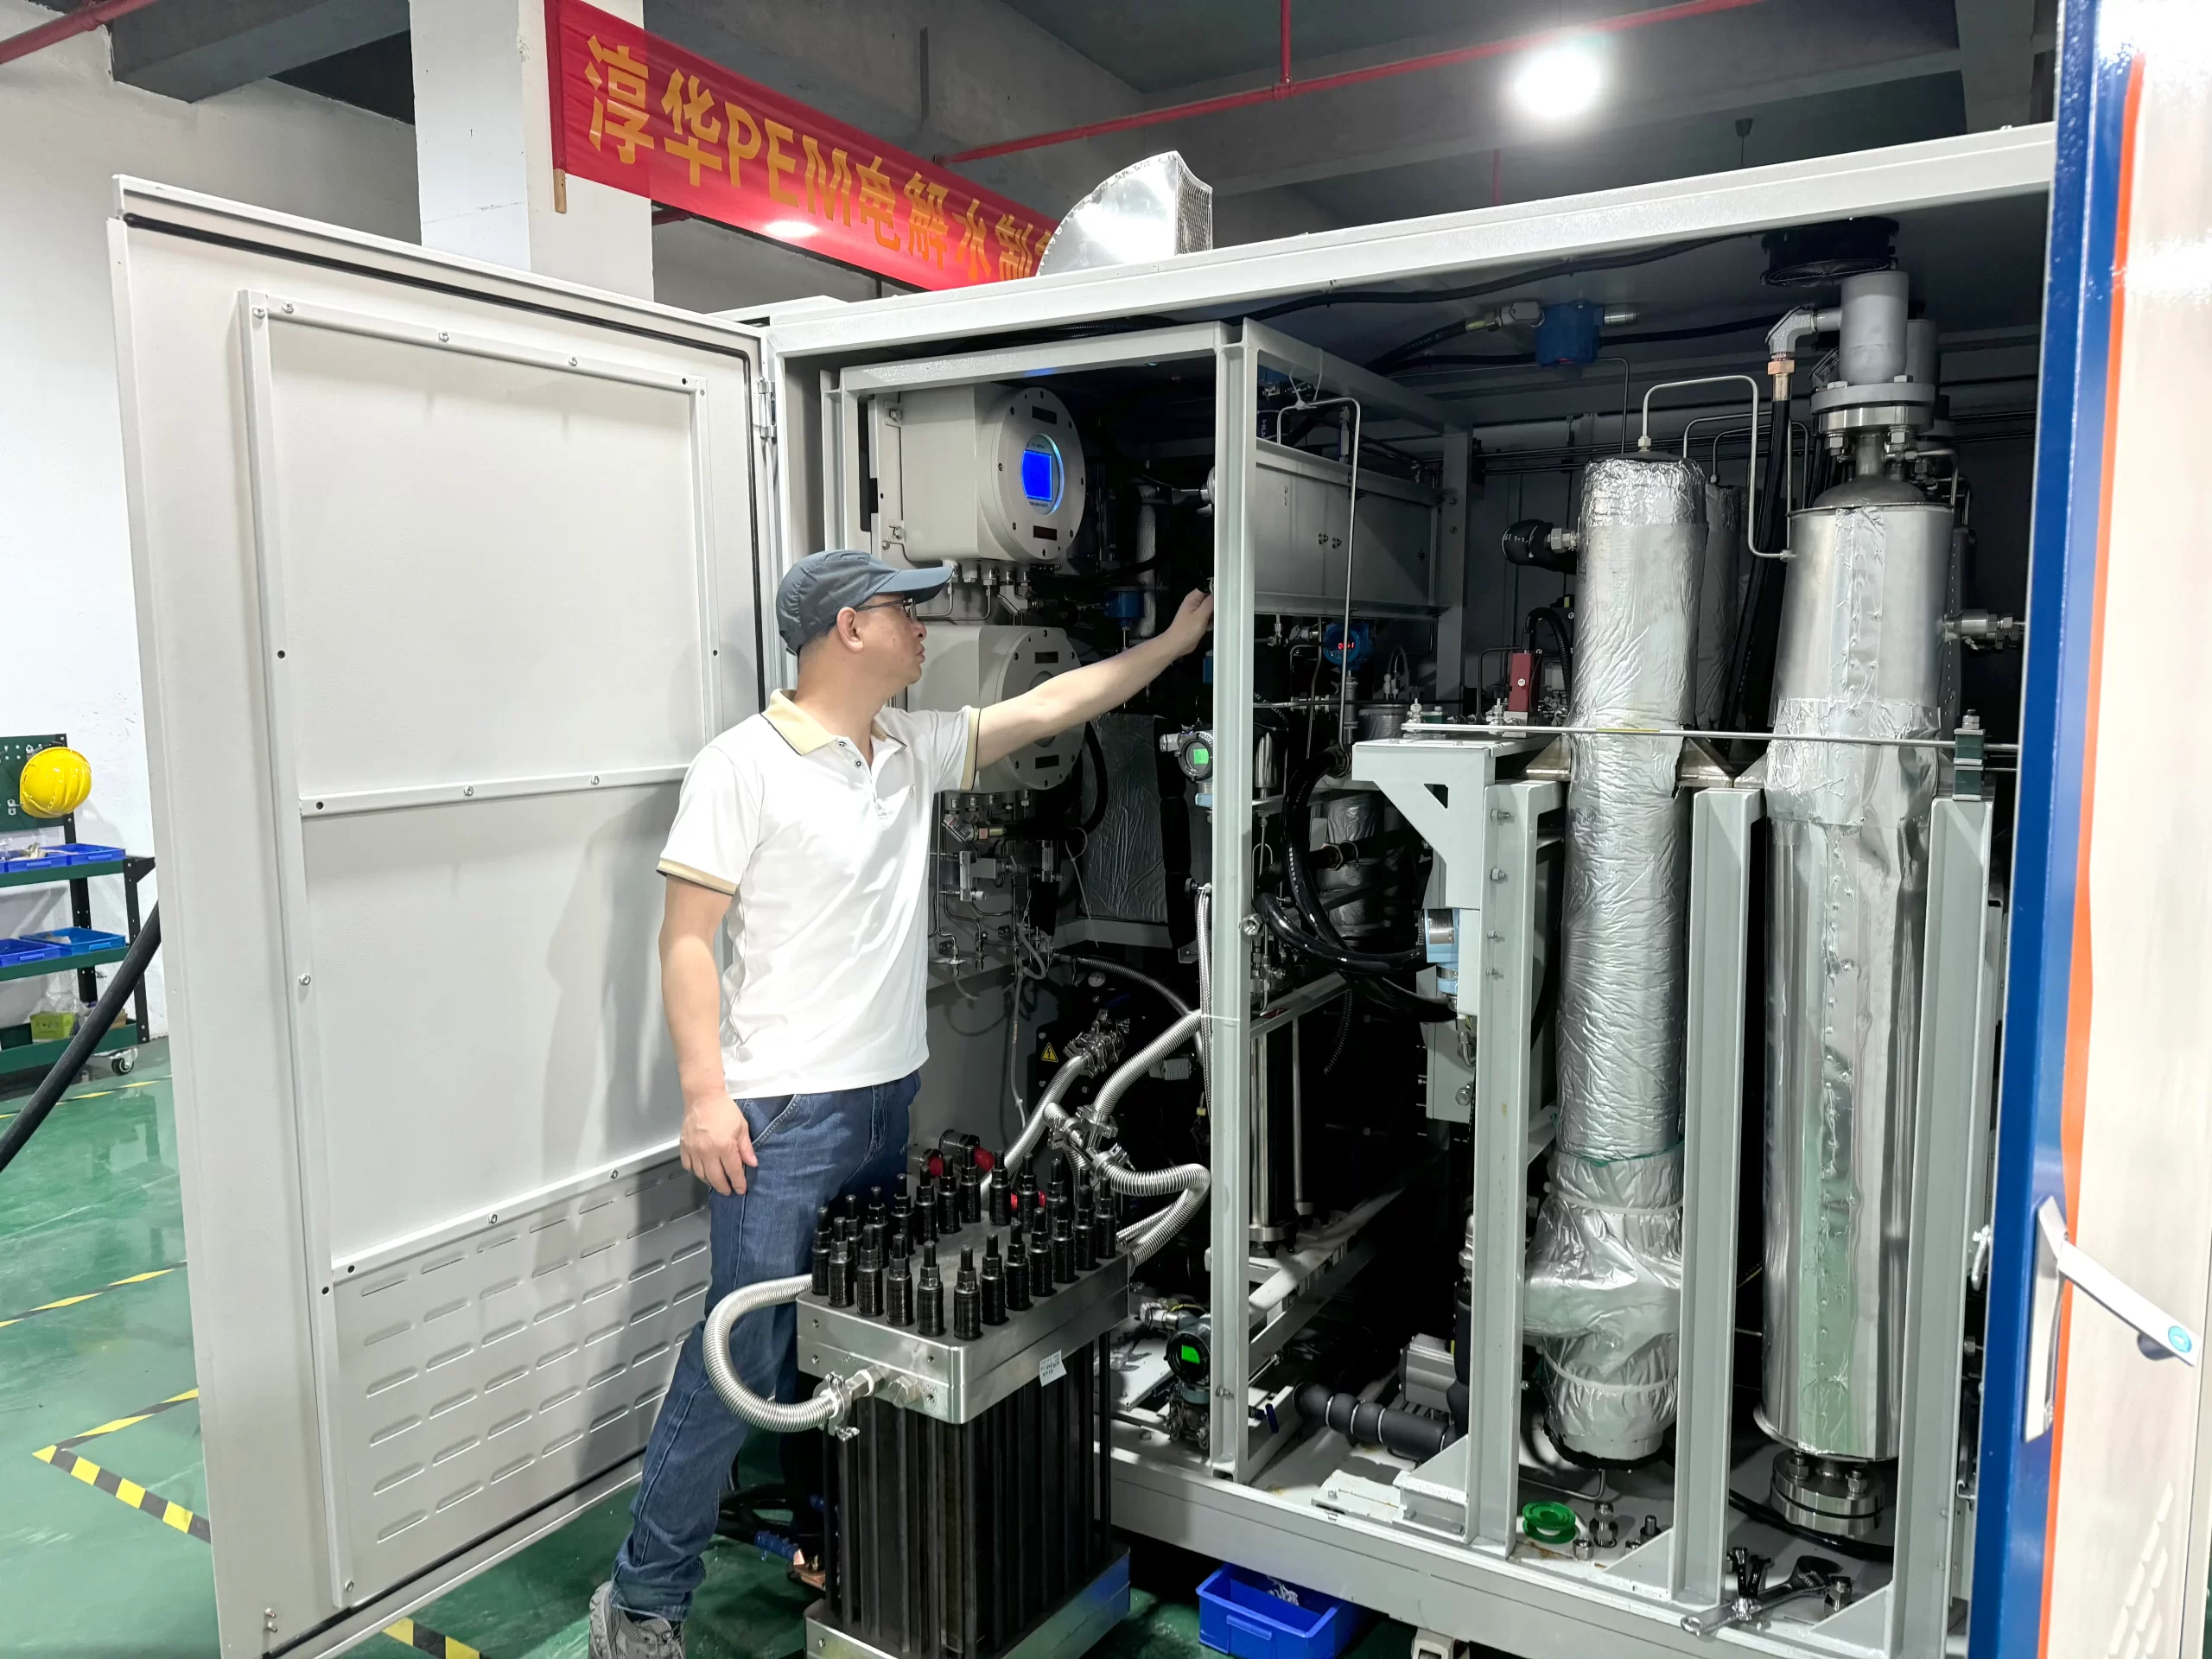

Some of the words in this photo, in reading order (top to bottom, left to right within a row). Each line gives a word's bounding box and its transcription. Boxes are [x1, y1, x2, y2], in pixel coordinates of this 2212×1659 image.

[586, 35, 1051, 281] 淳华PEM电解水制
